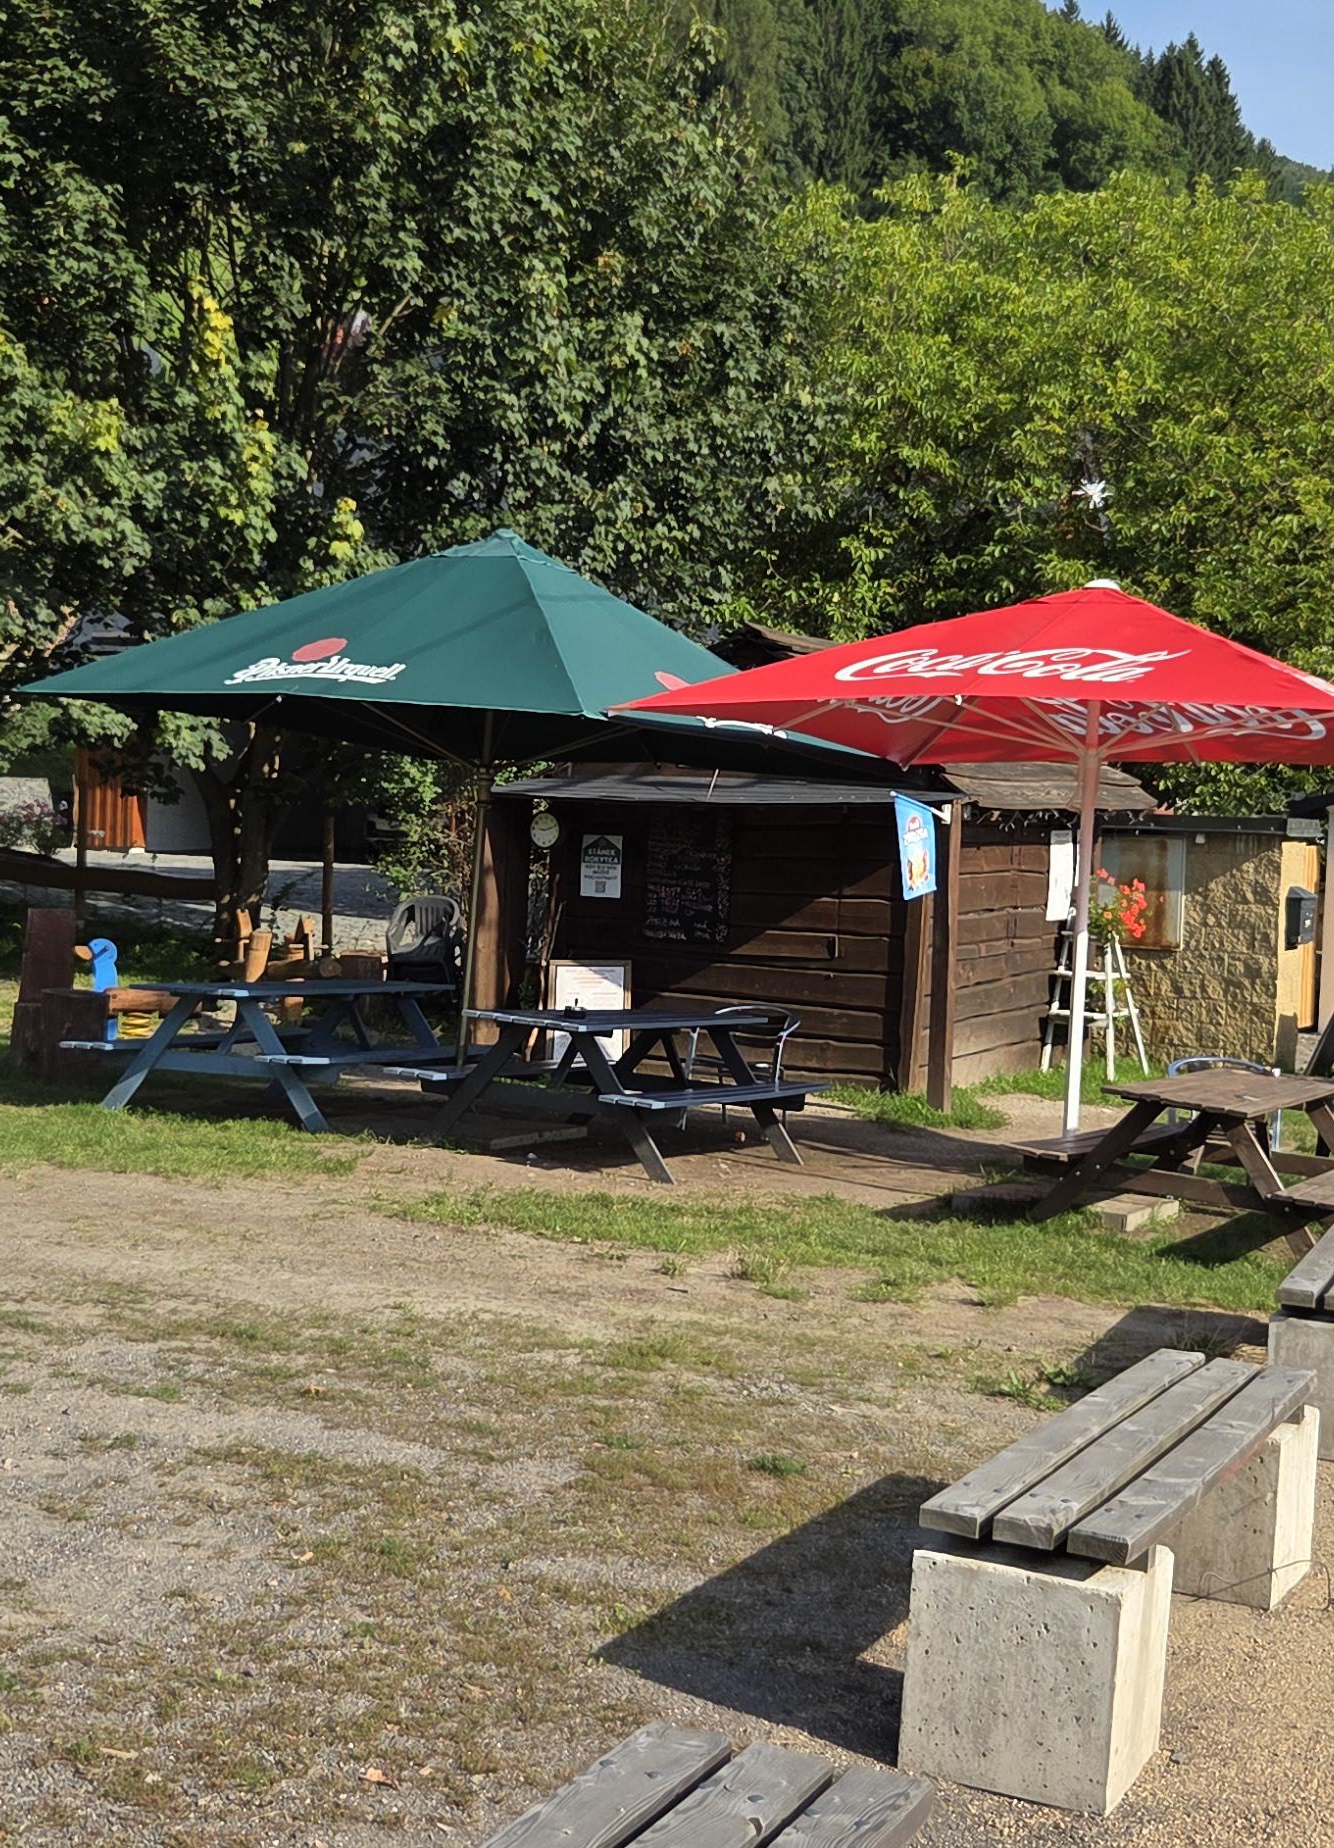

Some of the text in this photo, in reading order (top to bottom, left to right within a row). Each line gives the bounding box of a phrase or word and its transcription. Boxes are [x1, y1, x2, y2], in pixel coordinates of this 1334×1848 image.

[223, 655, 407, 685] Pilsner Urquell
[835, 648, 1192, 683] Coca-Cola
